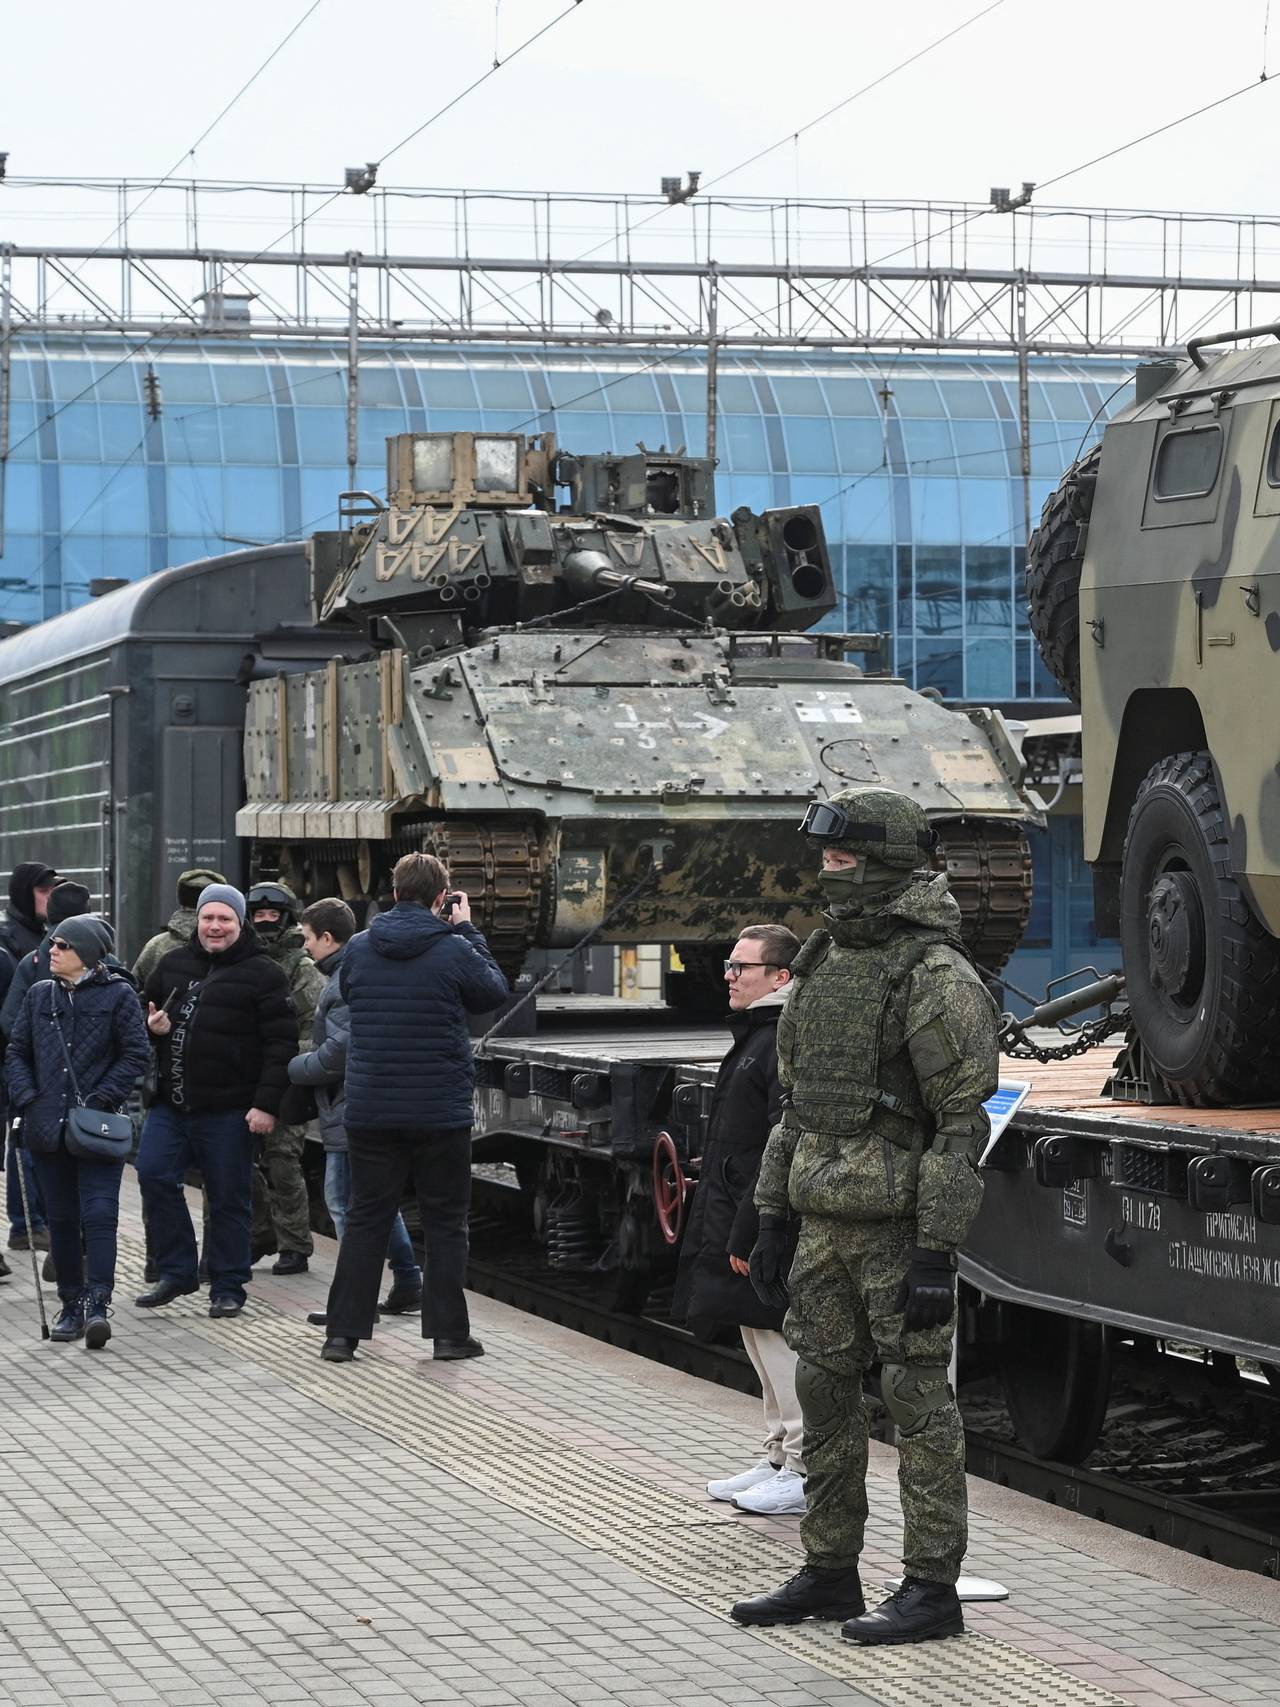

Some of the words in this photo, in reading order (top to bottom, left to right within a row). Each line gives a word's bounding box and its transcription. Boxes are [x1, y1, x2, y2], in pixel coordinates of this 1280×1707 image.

[180, 979, 200, 1020] JEAS
[171, 1020, 187, 1057] KLEIN
[171, 1057, 185, 1105] CALVIN
[1205, 1212, 1256, 1244] ПРИПИСАН
